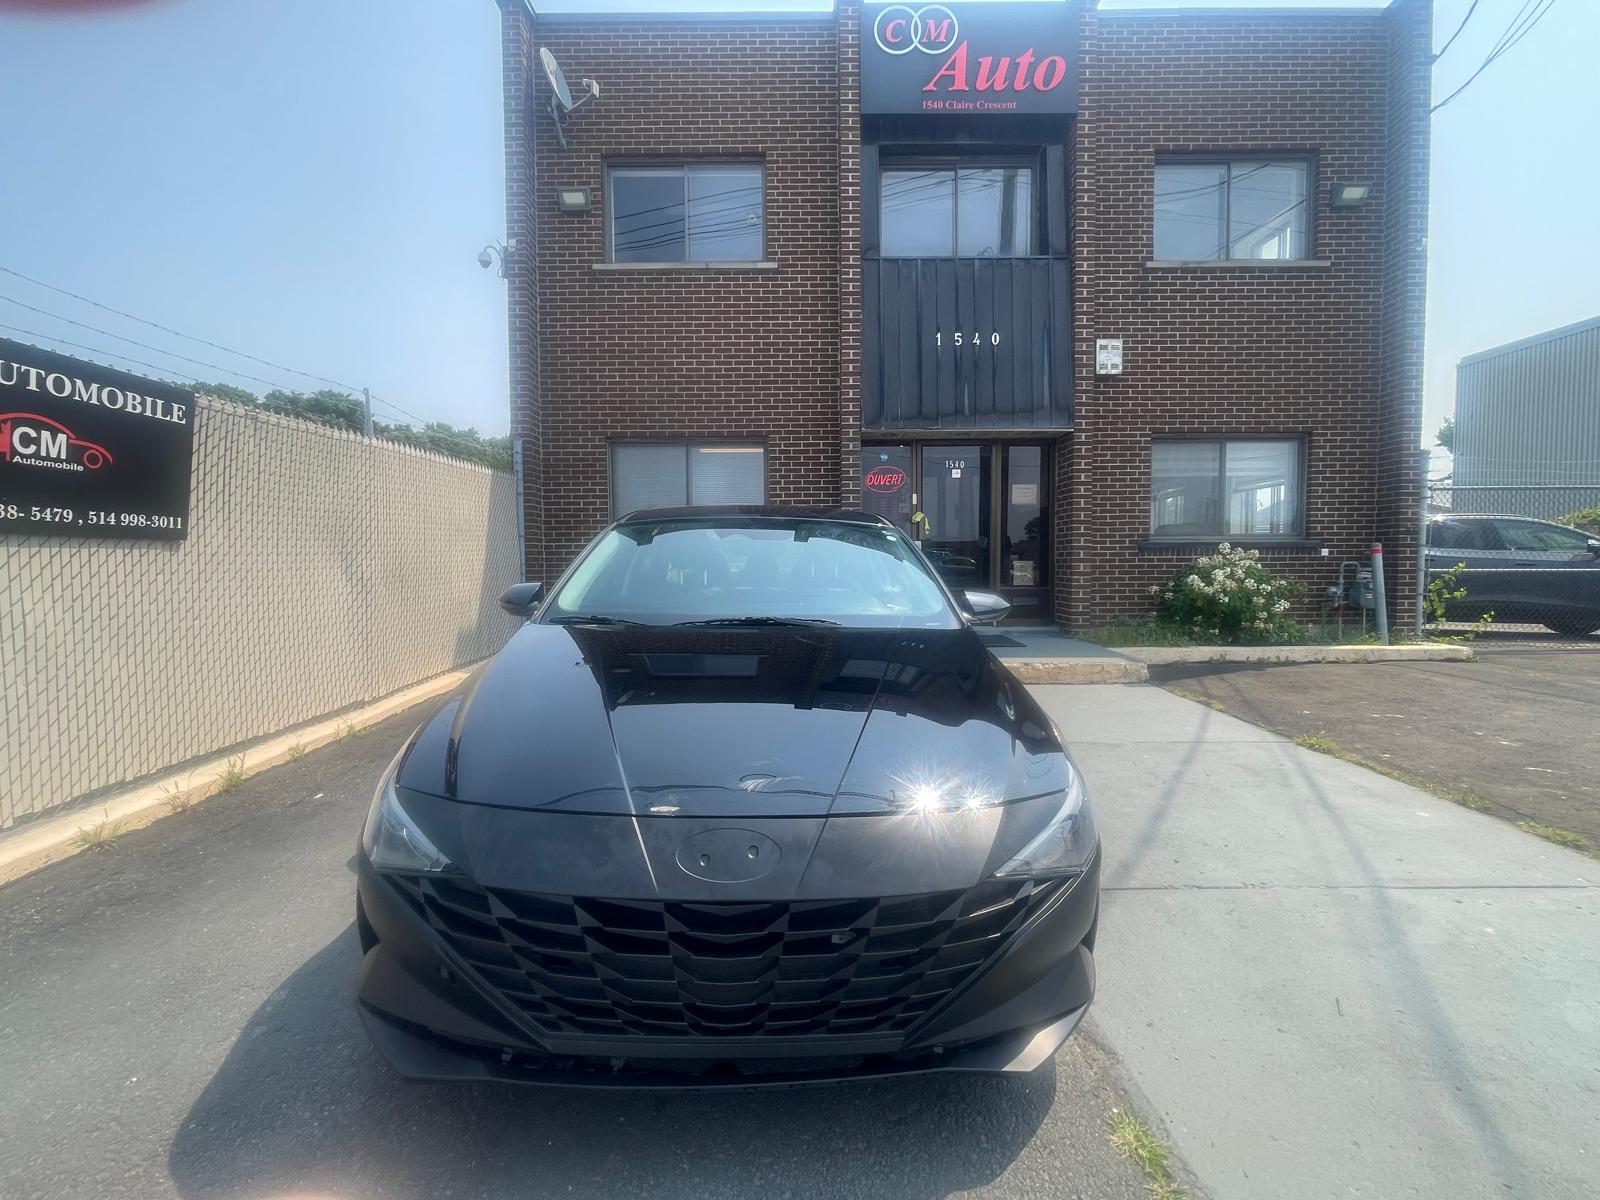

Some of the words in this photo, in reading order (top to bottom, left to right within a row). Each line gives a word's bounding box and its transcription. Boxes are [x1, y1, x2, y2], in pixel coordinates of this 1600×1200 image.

[922, 39, 1067, 92] Auto
[922, 100, 944, 110] 1540
[946, 100, 974, 110] Claire
[976, 100, 1017, 110] Crescent
[935, 332, 1000, 346] 1540
[0, 360, 186, 425] UTOMOBILE
[12, 426, 68, 460] CM
[12, 455, 84, 472] Automobile
[945, 460, 965, 469] 1540
[866, 474, 903, 486] OUVERT
[87, 511, 116, 525] 514
[120, 513, 183, 529] 998-3011
